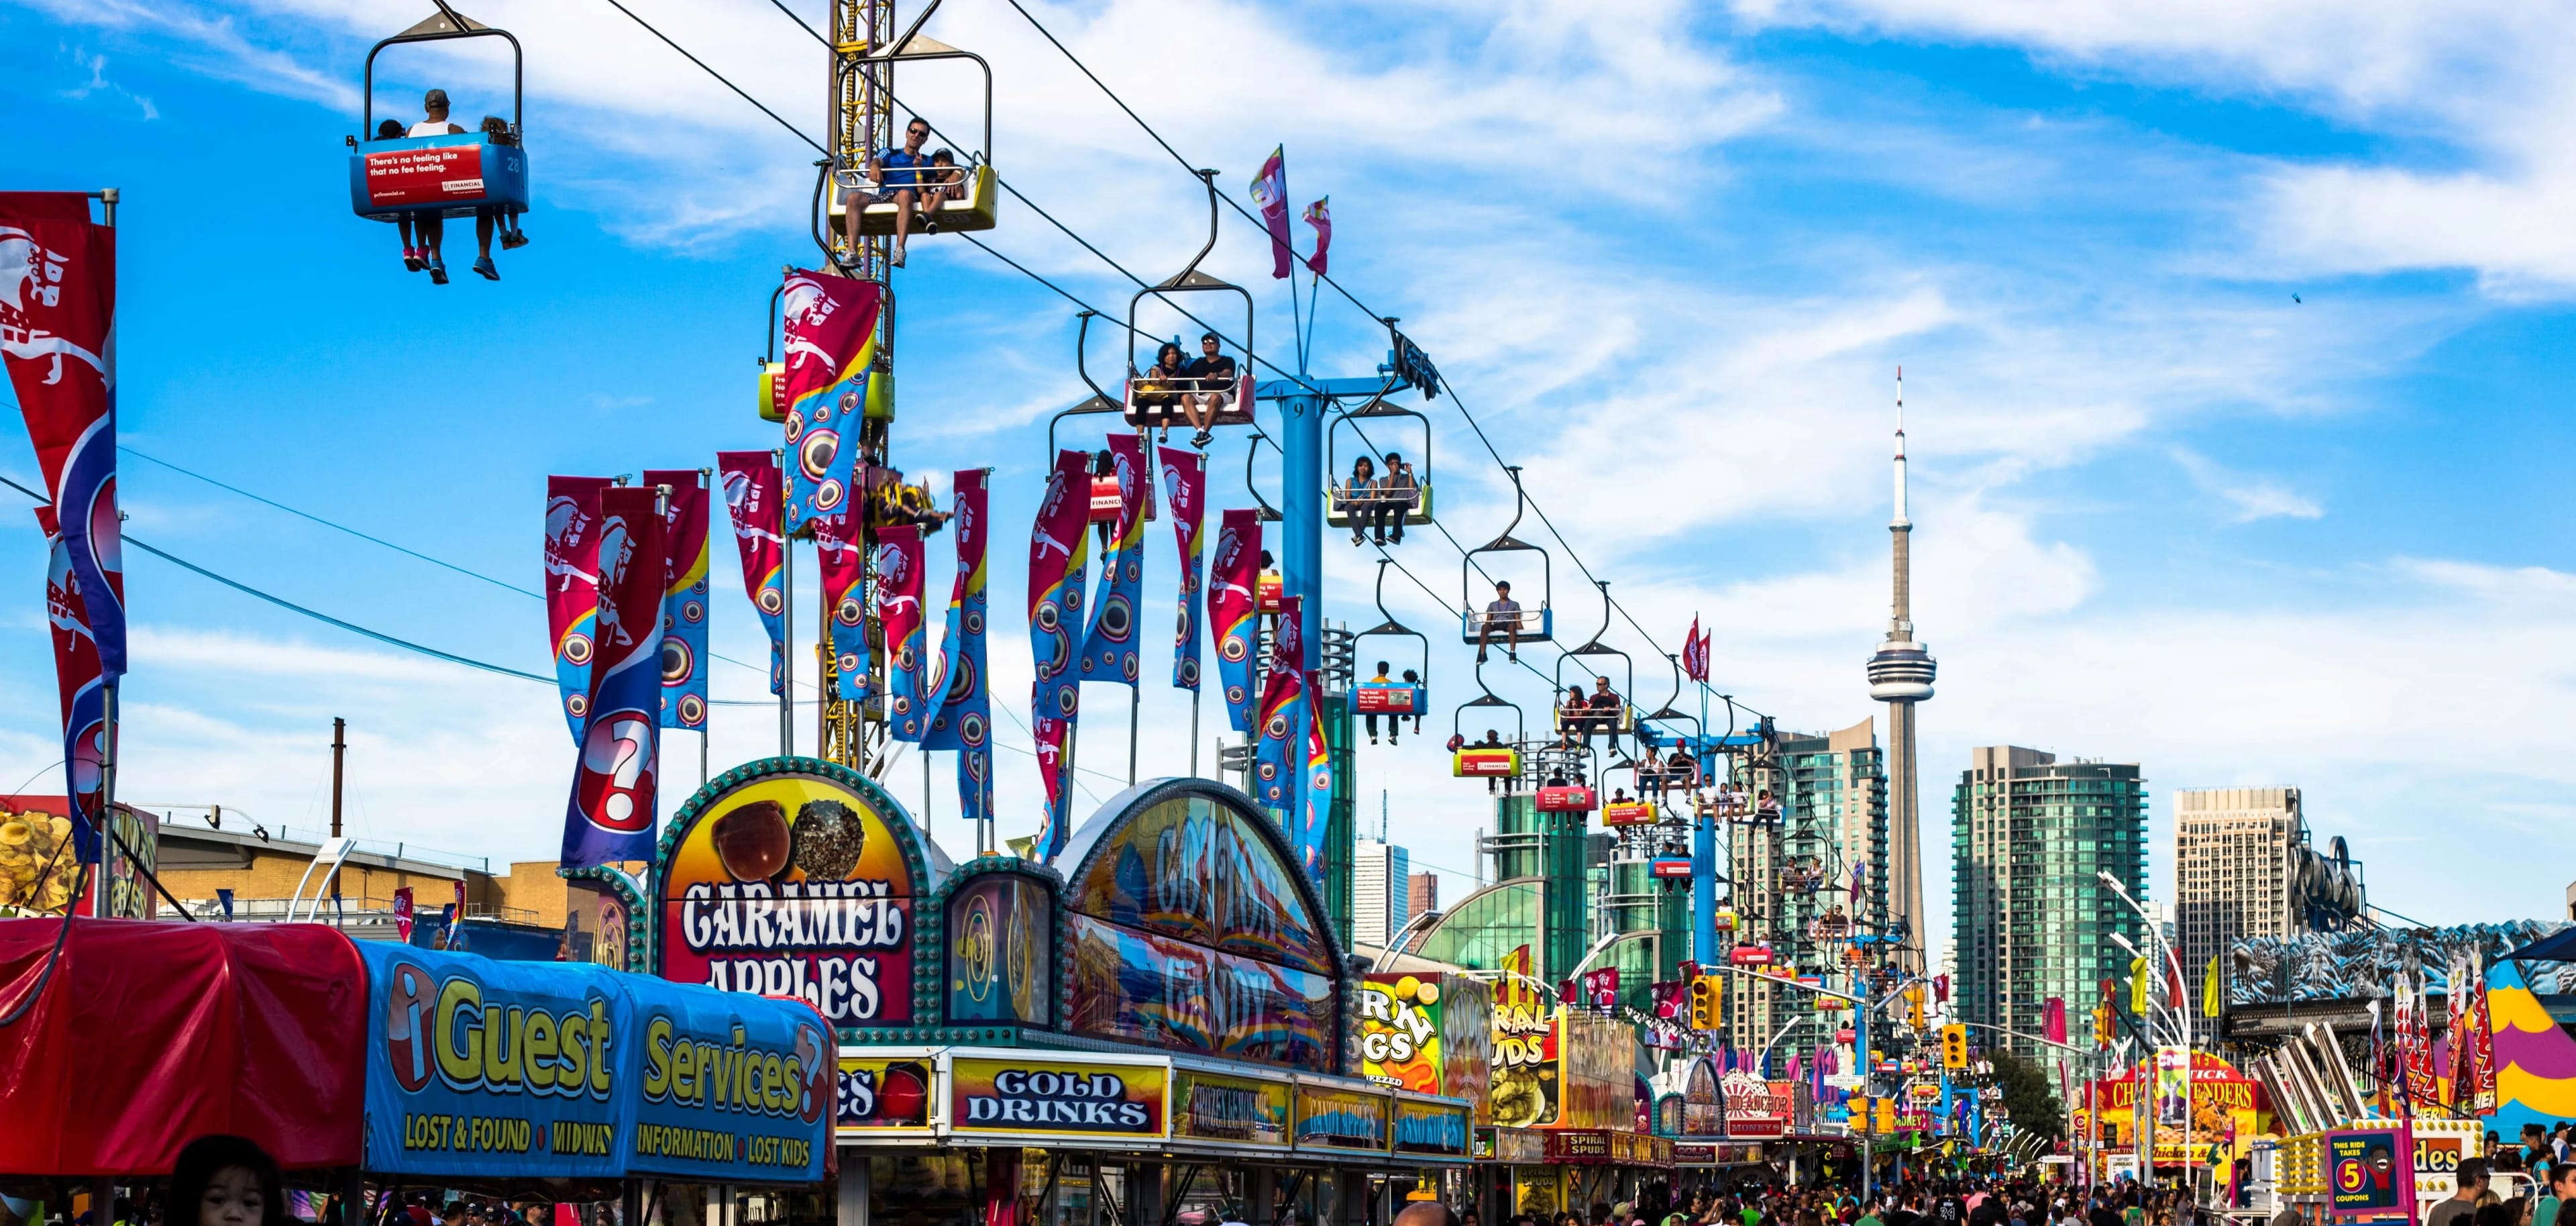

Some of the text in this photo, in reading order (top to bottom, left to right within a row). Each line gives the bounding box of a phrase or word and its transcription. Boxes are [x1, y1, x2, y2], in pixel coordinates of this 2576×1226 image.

[370, 156, 398, 166] There's
[413, 154, 440, 163] feeling
[443, 152, 458, 160] like
[507, 156, 519, 173] 28
[370, 168, 386, 176] that
[401, 165, 415, 174] fee
[417, 164, 446, 172] feeling.
[1293, 402, 1304, 419] 9
[683, 880, 902, 948] CARAMEL
[706, 957, 879, 1019] APPLES
[1493, 1004, 1551, 1035] RAL
[433, 976, 612, 1101] Guest
[1363, 1032, 1412, 1062] GS
[1492, 1035, 1544, 1067] UDS
[644, 1016, 802, 1119] Services
[995, 1069, 1123, 1098] COLD
[967, 1096, 1146, 1127] DRINKS
[1746, 1095, 1788, 1113] ANCHOR
[1894, 1115, 1923, 1128] MONEY
[405, 1113, 616, 1155] LOST & FOUND MIDWAY
[1570, 1136, 1606, 1145] SPIRAL
[637, 1123, 810, 1167] INFORMATION LOST KIDS
[1572, 1145, 1605, 1154] SPUDS
[1678, 1147, 1707, 1155] COLD
[2152, 1146, 2208, 1158] hicken &
[2349, 1141, 2365, 1149] RIDE
[1523, 1176, 1554, 1186] SPUDS
[2345, 1163, 2360, 1188] 5
[2335, 1194, 2369, 1203] COUPONS
[1940, 1207, 1955, 1221] 24
